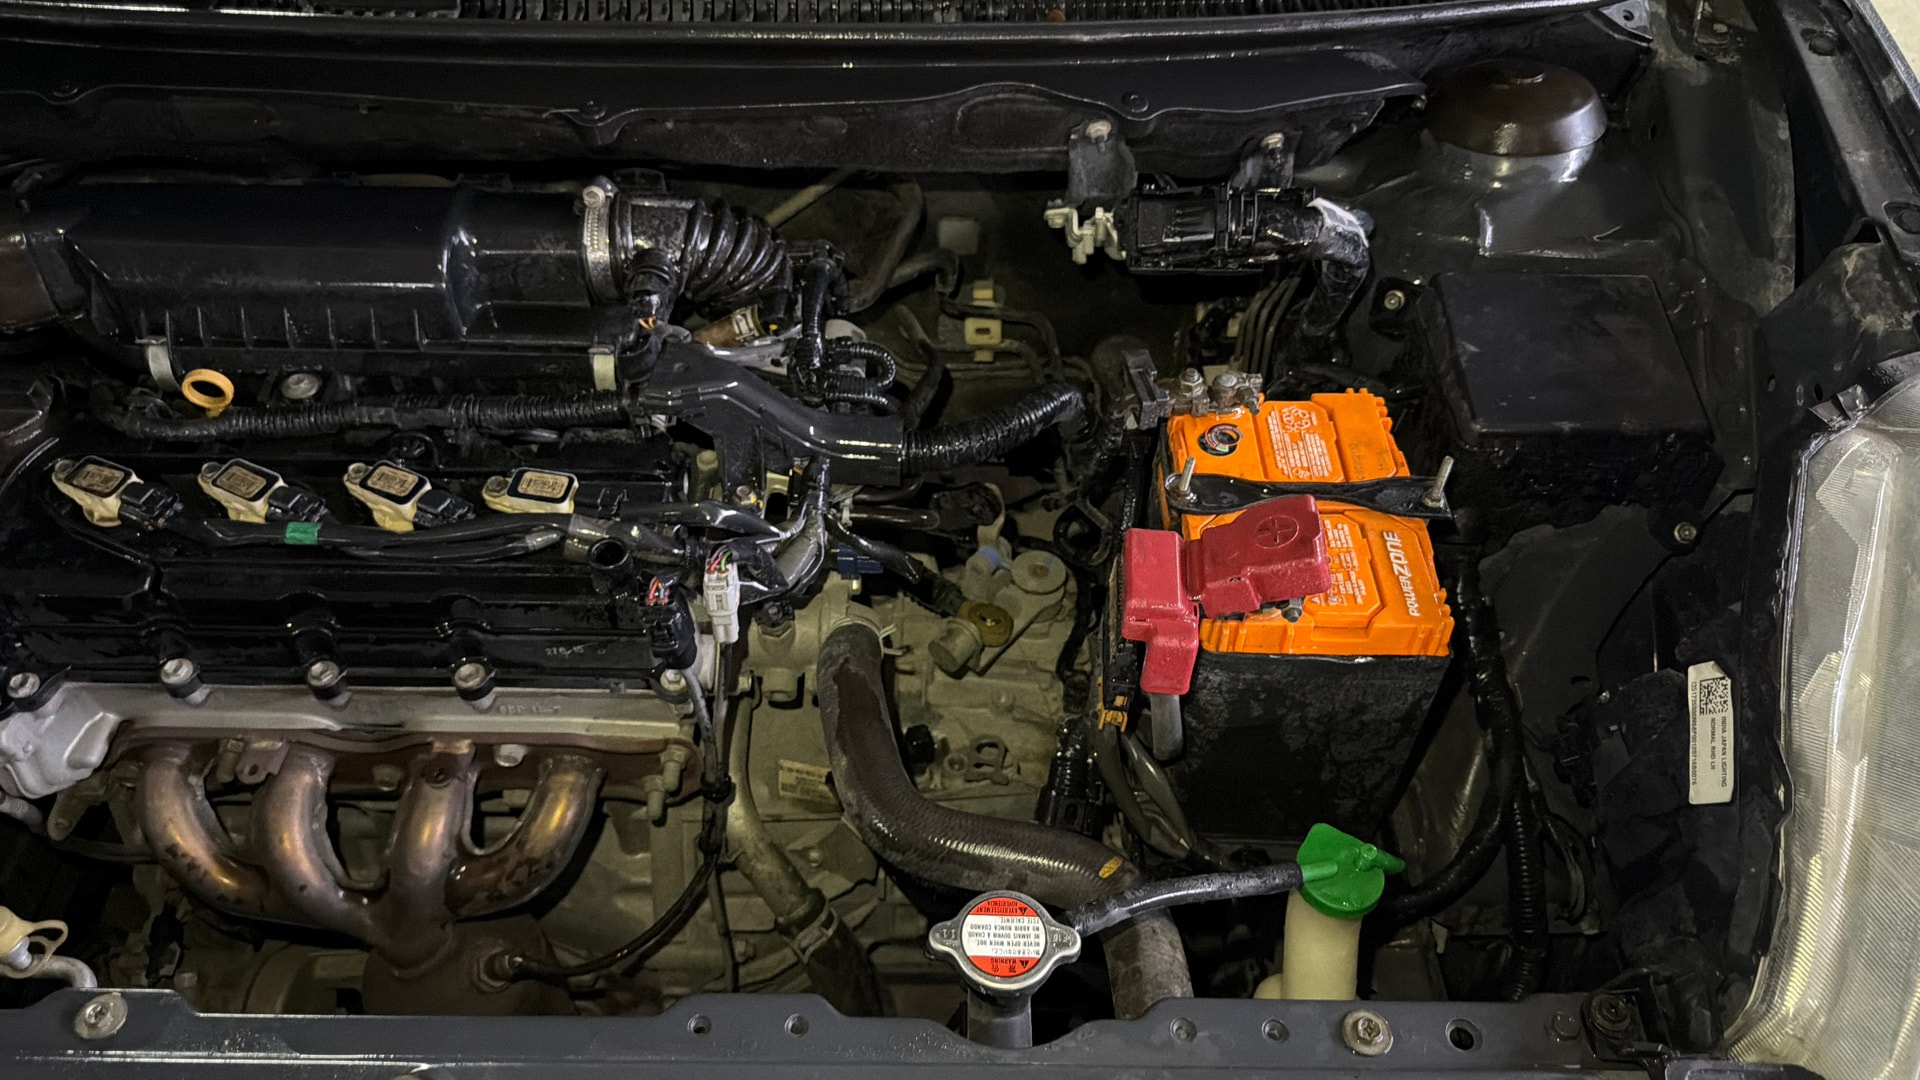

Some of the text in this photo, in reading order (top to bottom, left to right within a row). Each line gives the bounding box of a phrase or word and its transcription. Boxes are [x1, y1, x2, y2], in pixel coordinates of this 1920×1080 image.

[1383, 531, 1421, 617] POWERZONE
[1710, 760, 1717, 770] LH
[970, 923, 992, 931] CUANDO
